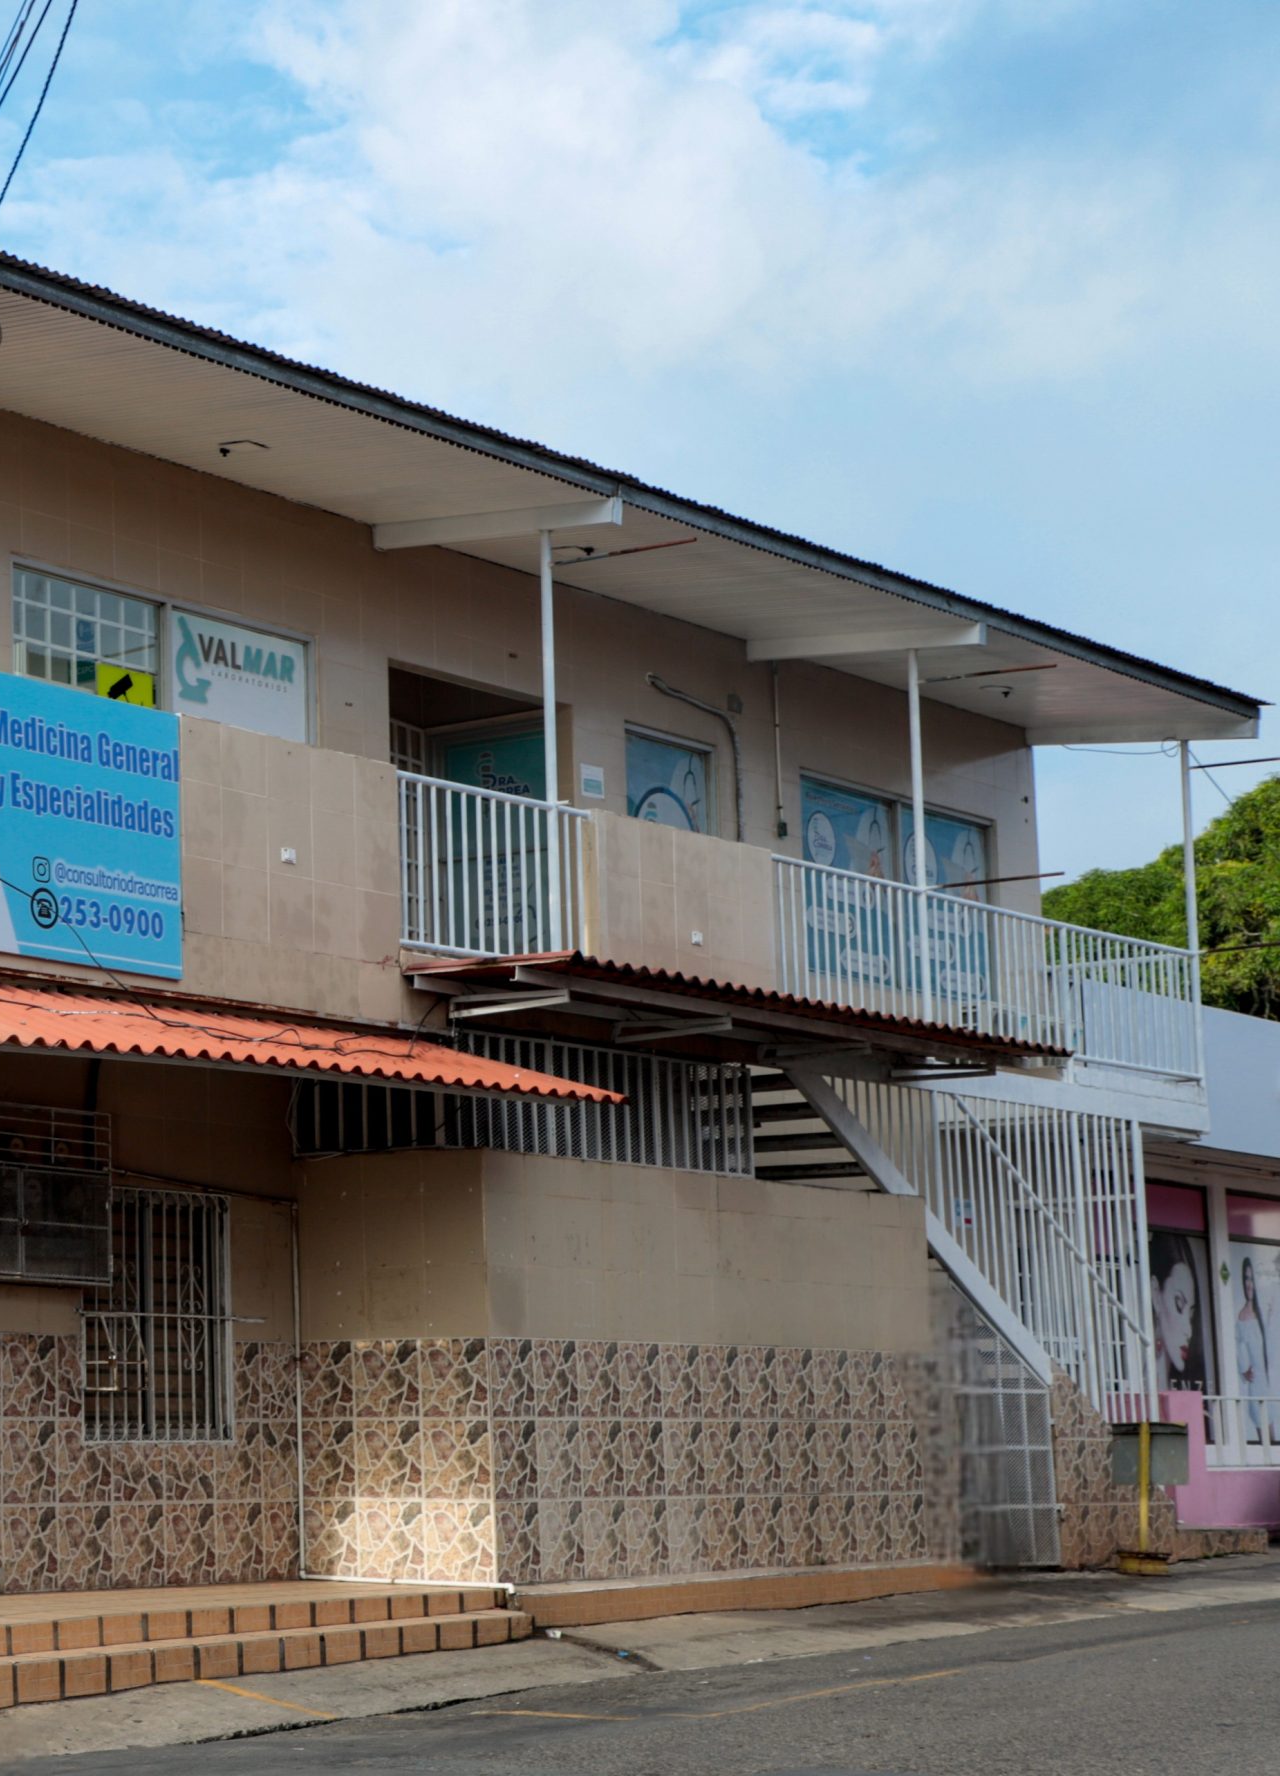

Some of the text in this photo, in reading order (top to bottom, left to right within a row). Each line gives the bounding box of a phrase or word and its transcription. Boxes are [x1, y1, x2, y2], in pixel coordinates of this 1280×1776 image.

[198, 633, 295, 684] VALMAR
[211, 669, 288, 694] LABORATORIOS
[98, 733, 179, 782] General
[10, 772, 175, 838] Especialidades
[55, 862, 178, 902] @consultoriodracorrea
[60, 895, 164, 939] 253-0900
